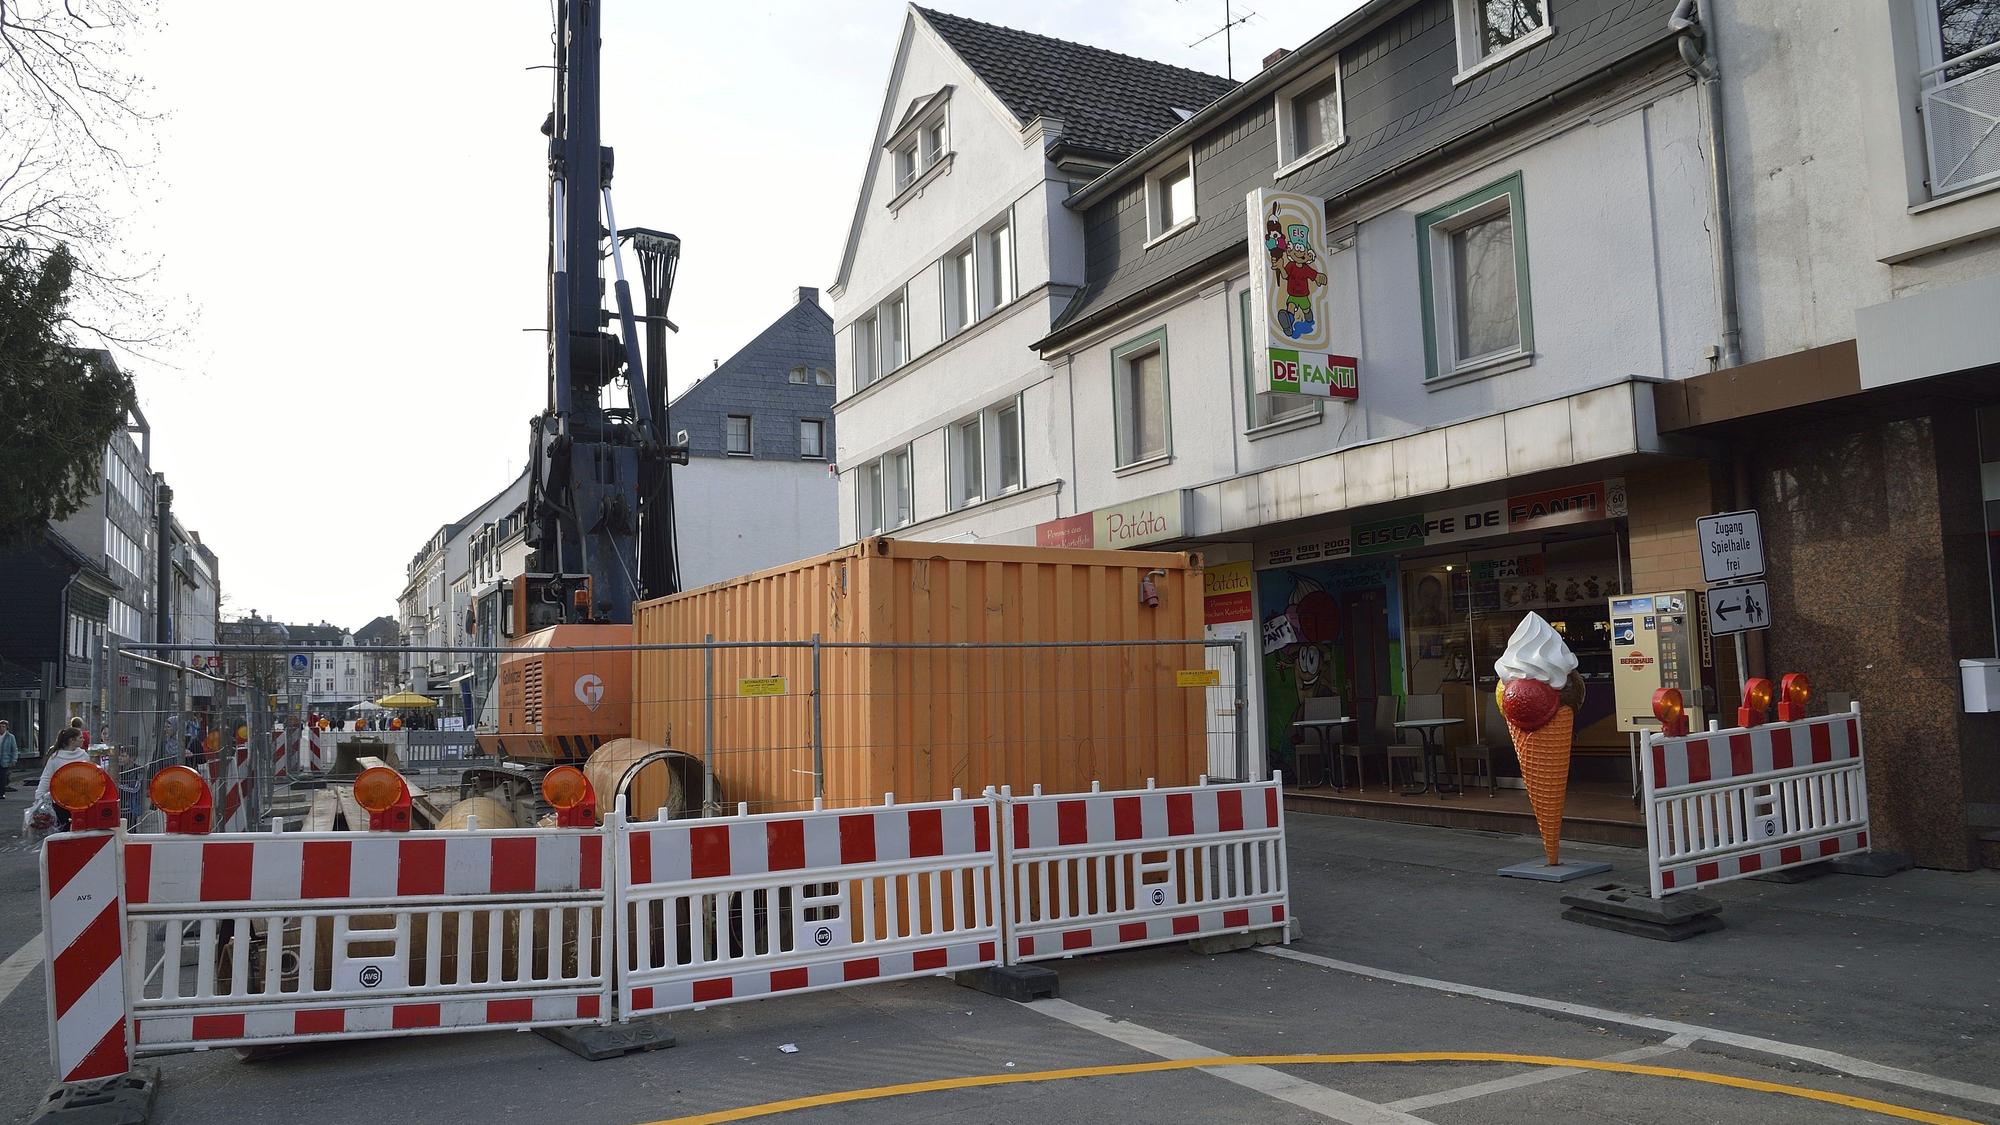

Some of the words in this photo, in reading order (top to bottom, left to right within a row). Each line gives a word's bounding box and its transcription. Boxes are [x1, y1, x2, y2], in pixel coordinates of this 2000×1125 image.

[1292, 228, 1305, 239] EIS
[1272, 359, 1300, 382] DE
[1302, 364, 1356, 389] FANTI
[1612, 493, 1624, 504] 60
[1106, 510, 1167, 542] Patáta
[1357, 517, 1455, 547] EISCAFE
[1464, 510, 1500, 530] DE
[1510, 492, 1598, 524] FANTI
[1714, 522, 1744, 537] Zugang
[1270, 548, 1292, 557] 1952
[1297, 543, 1319, 552] 1981
[1324, 538, 1350, 549] 2003
[1711, 538, 1751, 556] Spielhalle
[1726, 557, 1741, 571] frei
[1203, 571, 1249, 593] Patáta
[1263, 620, 1275, 632] DE
[1700, 596, 1711, 666] CIGARETTEN
[1620, 657, 1654, 665] BERGHAUS
